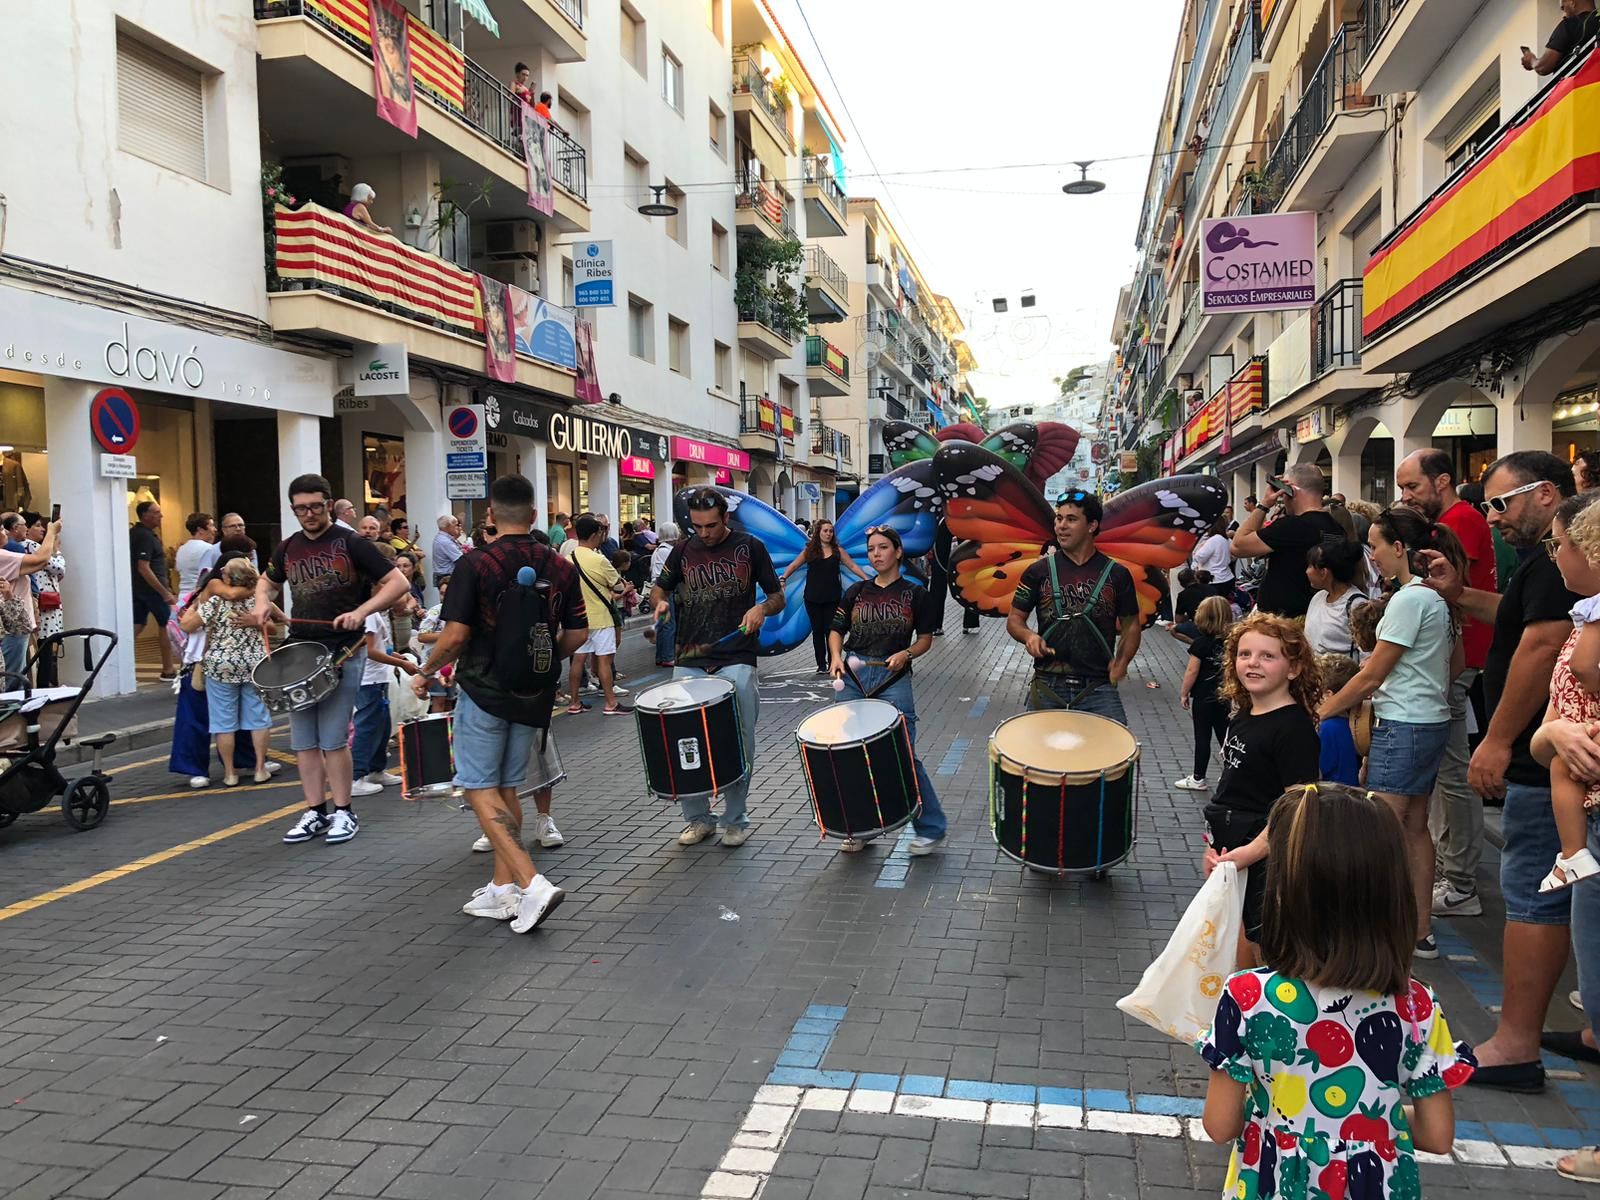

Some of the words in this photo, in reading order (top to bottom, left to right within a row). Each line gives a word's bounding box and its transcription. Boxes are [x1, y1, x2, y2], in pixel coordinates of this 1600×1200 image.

[575, 259, 606, 268] Clínica
[1206, 256, 1313, 281] COSTAMED
[586, 268, 612, 277] Ribes
[1207, 293, 1248, 305] SERVICIOS
[1250, 290, 1313, 303] EMPRESARIALES
[5, 344, 83, 370] desde
[104, 322, 204, 390] davó
[220, 380, 273, 402] 1970
[359, 371, 400, 382] LACOSTE
[338, 398, 369, 409] Ribes
[512, 409, 539, 429] Calzados
[550, 413, 632, 460] GUILLERMO
